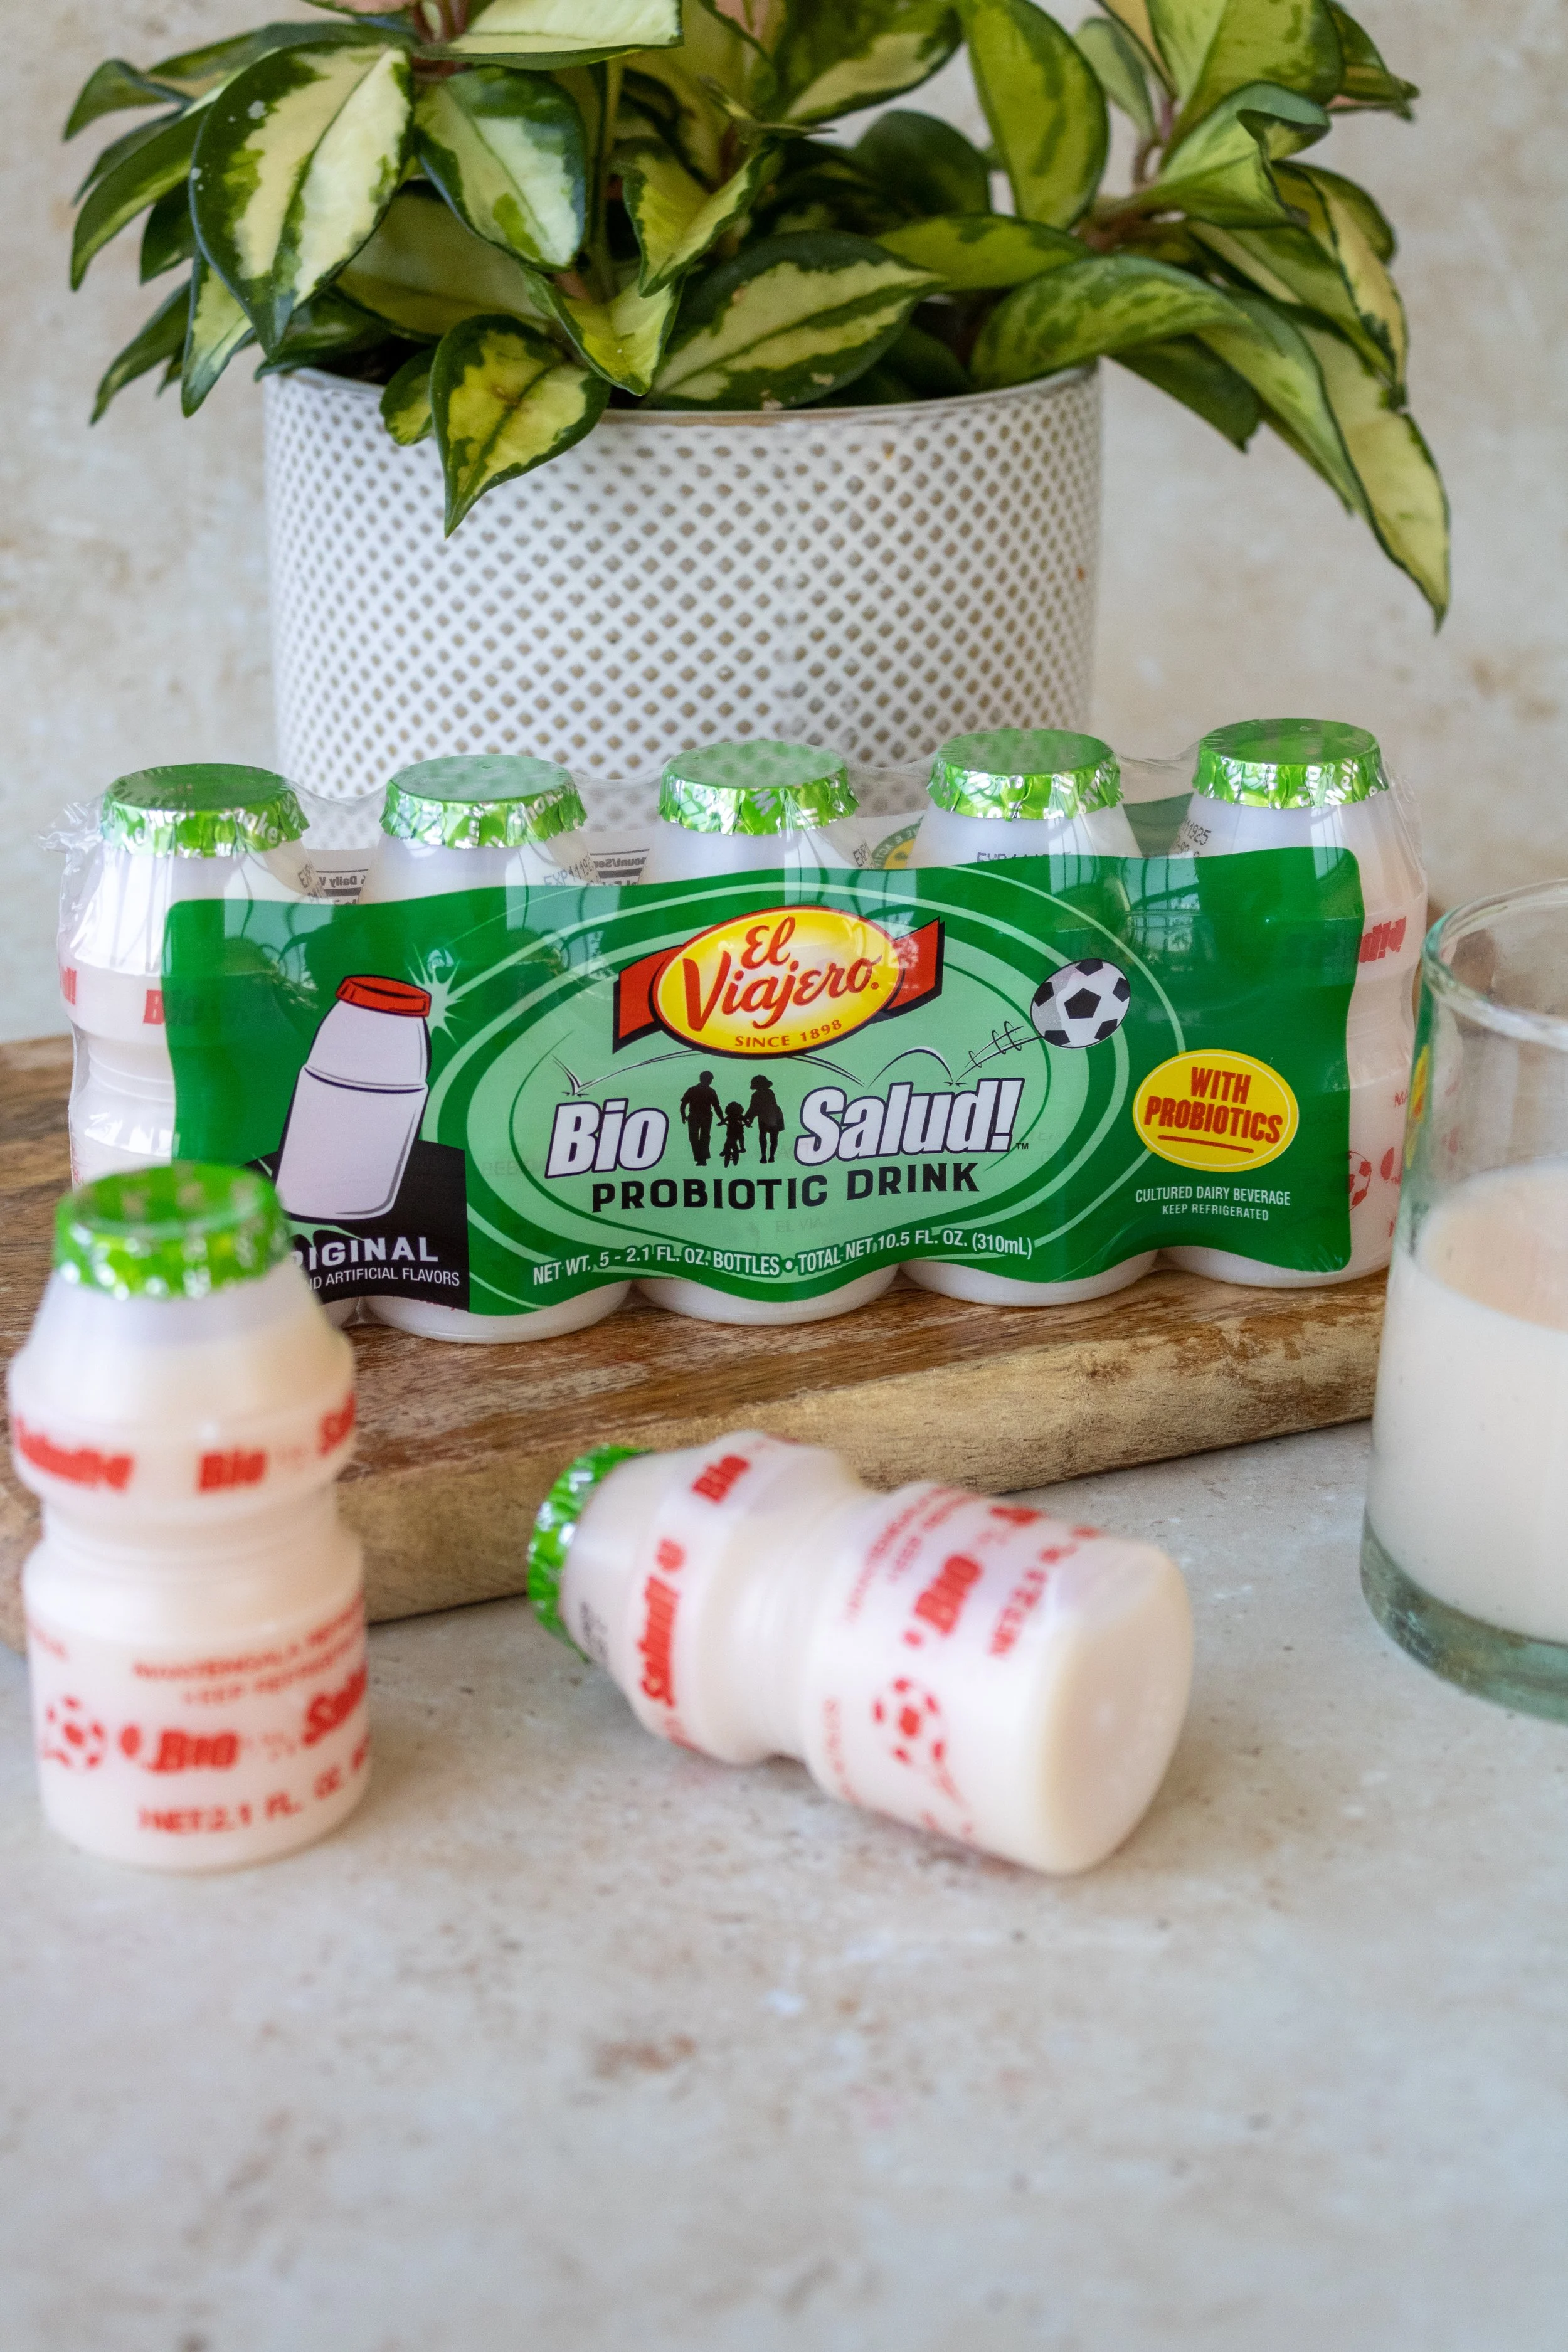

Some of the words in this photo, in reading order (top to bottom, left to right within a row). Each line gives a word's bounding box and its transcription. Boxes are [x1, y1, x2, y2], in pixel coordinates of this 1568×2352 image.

[741, 916, 796, 970] El
[735, 1036, 790, 1048] SINCE
[800, 1019, 842, 1042] 1898
[1190, 1066, 1252, 1105] WITH
[545, 1098, 669, 1179] Bio
[794, 1078, 1025, 1167] Salud!
[1143, 1096, 1283, 1145] PROBIOTICS
[591, 1175, 828, 1213] PROBIOTIC
[846, 1162, 980, 1201] DRINK
[1135, 1185, 1193, 1203] CULTURED
[1196, 1186, 1230, 1200] DAIRY
[1233, 1187, 1291, 1206] BEVERAGE
[1162, 1204, 1188, 1216] KEEP
[1191, 1204, 1269, 1221] REFRIGERATED
[326, 1267, 398, 1286] ARTIFICIAL
[402, 1267, 460, 1286] FLAVORS
[533, 1261, 562, 1286] NET
[565, 1254, 591, 1276] WT.
[600, 1251, 610, 1267] 5
[626, 1246, 650, 1263] 2.1
[657, 1246, 680, 1262] FL.
[684, 1247, 709, 1266] OZ.
[713, 1251, 780, 1276] BOTTLES
[798, 1249, 842, 1274] TOTAL
[845, 1237, 874, 1260] NET
[877, 1232, 910, 1251] 10.5
[915, 1229, 938, 1245] FL.
[943, 1229, 968, 1247] OZ.
[972, 1232, 1032, 1261] (310mL)
